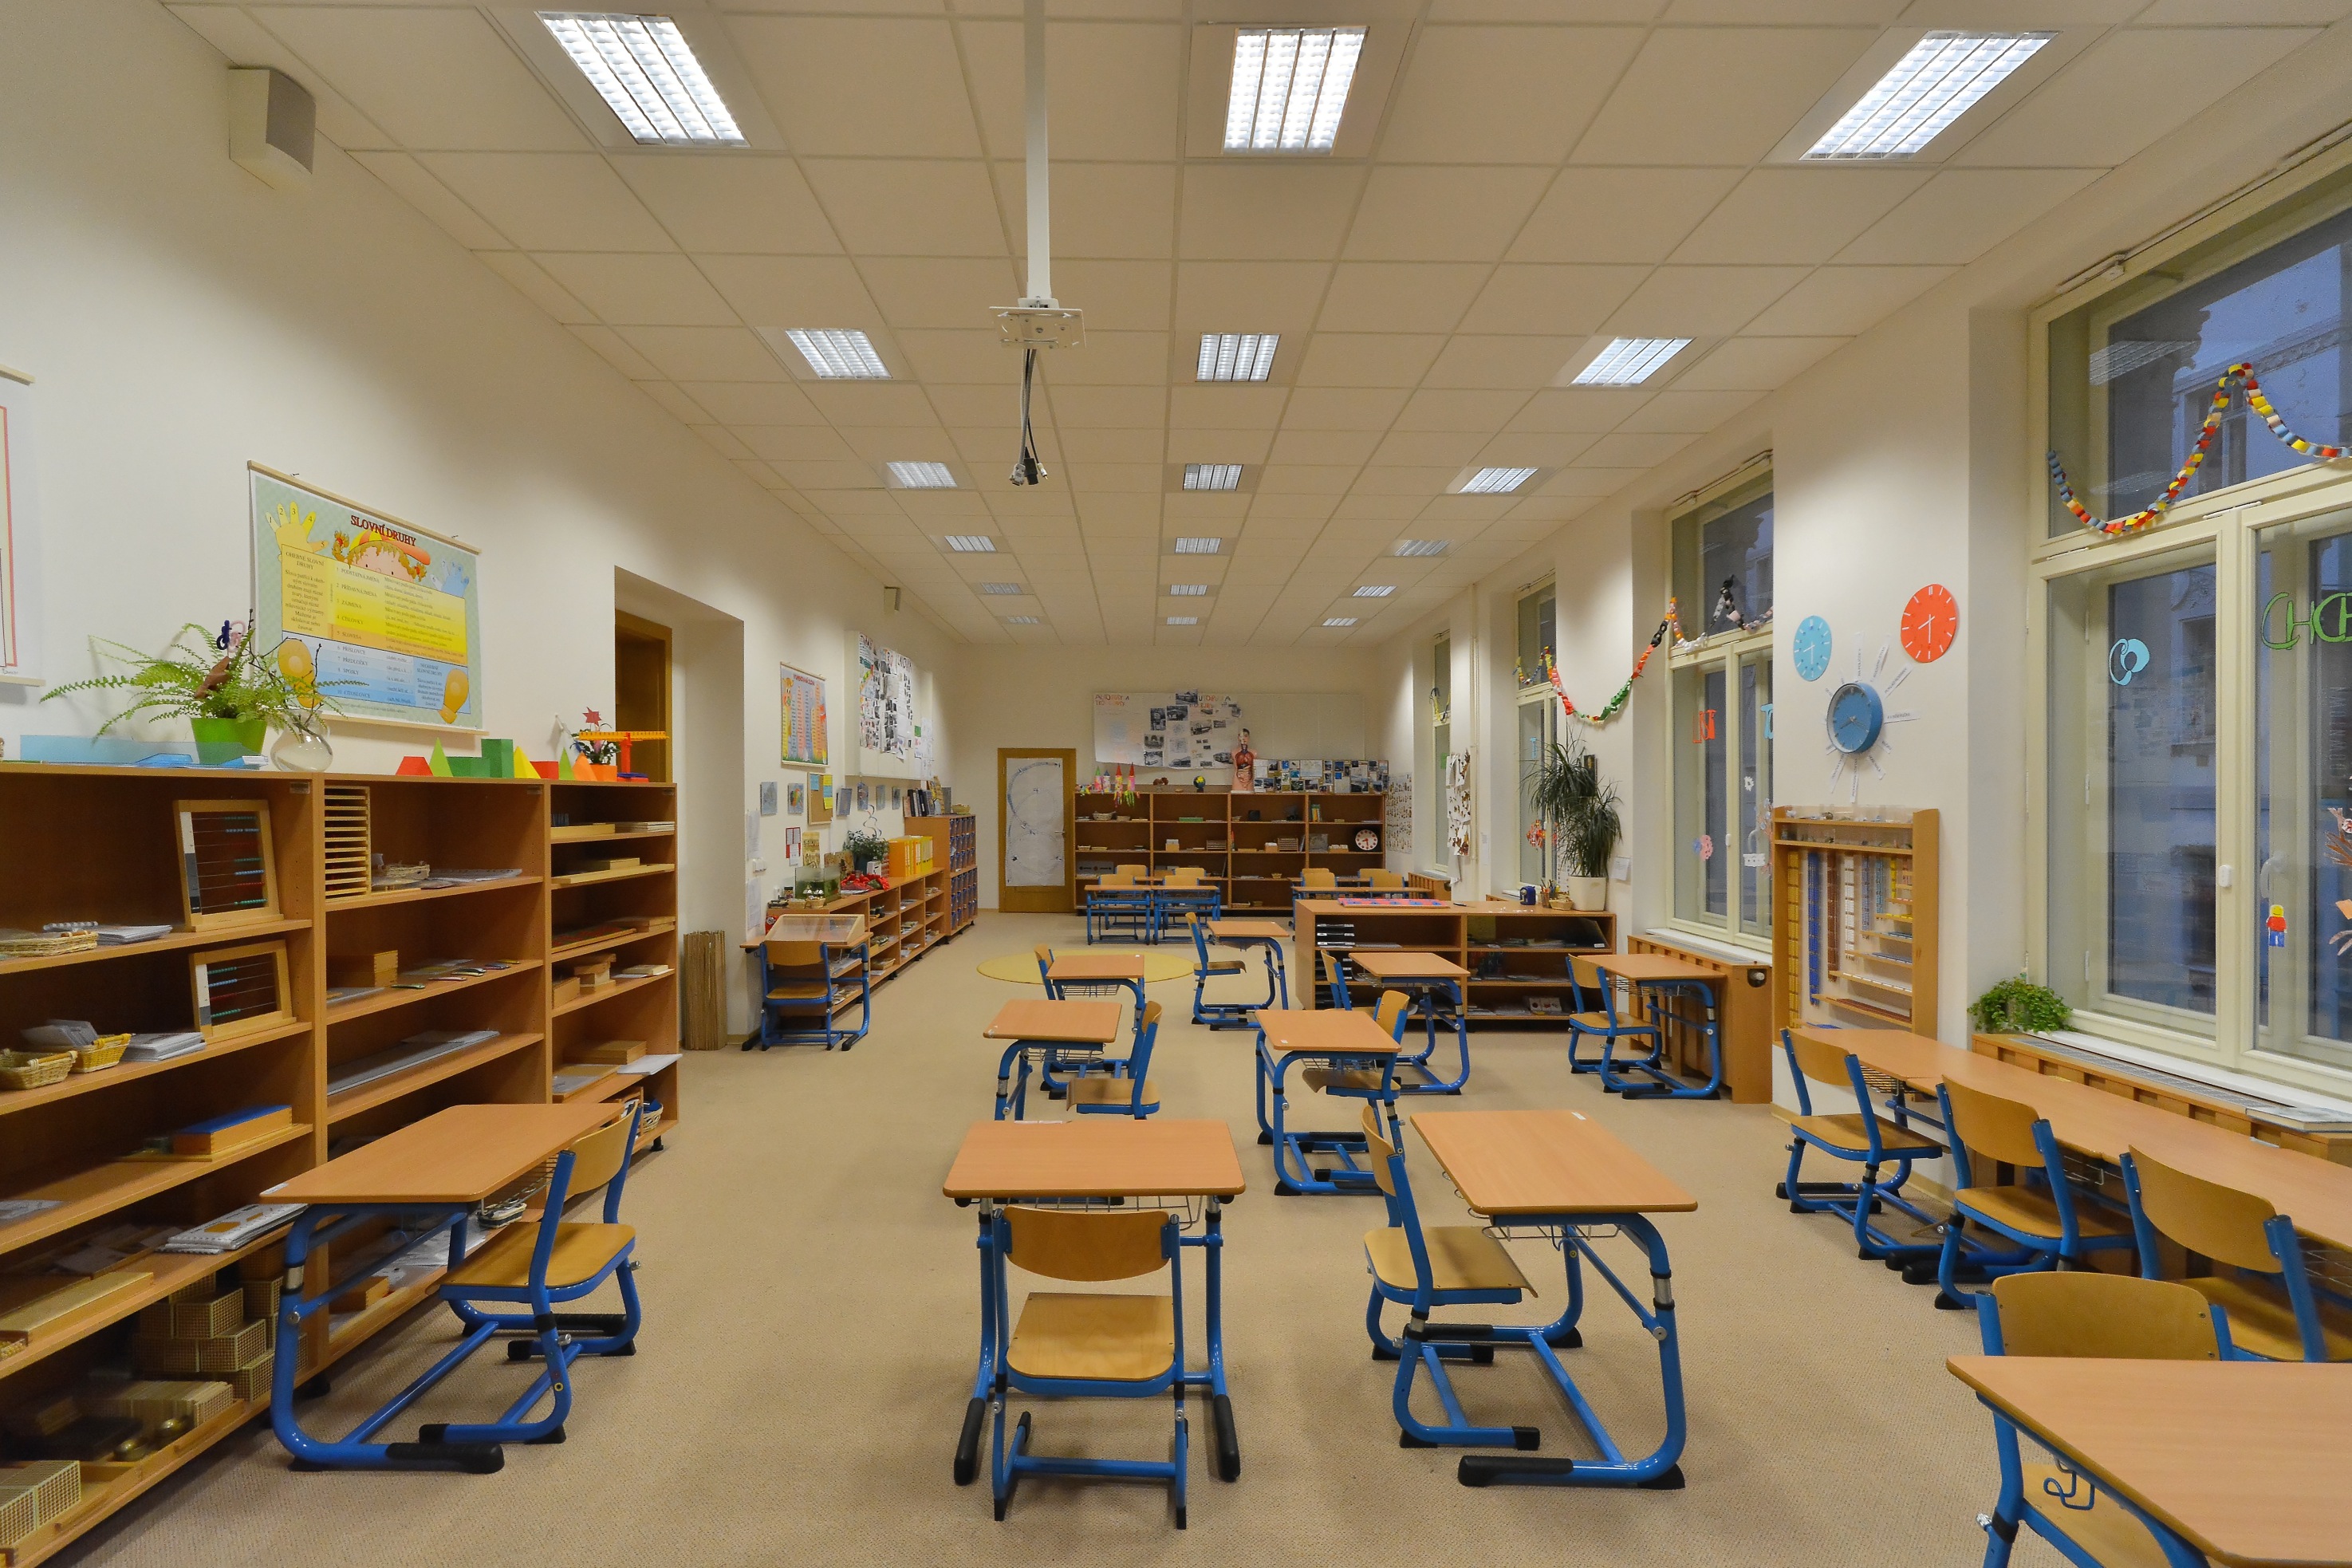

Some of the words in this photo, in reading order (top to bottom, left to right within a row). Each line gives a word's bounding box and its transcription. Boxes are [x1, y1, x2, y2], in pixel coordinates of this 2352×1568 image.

[351, 515, 385, 536] SLOVNÍ
[385, 529, 416, 547] DRUHY
[297, 561, 314, 569] DRUHY
[307, 557, 324, 566] SLOVNÍ
[343, 657, 368, 666] PŘEDLOŽKY
